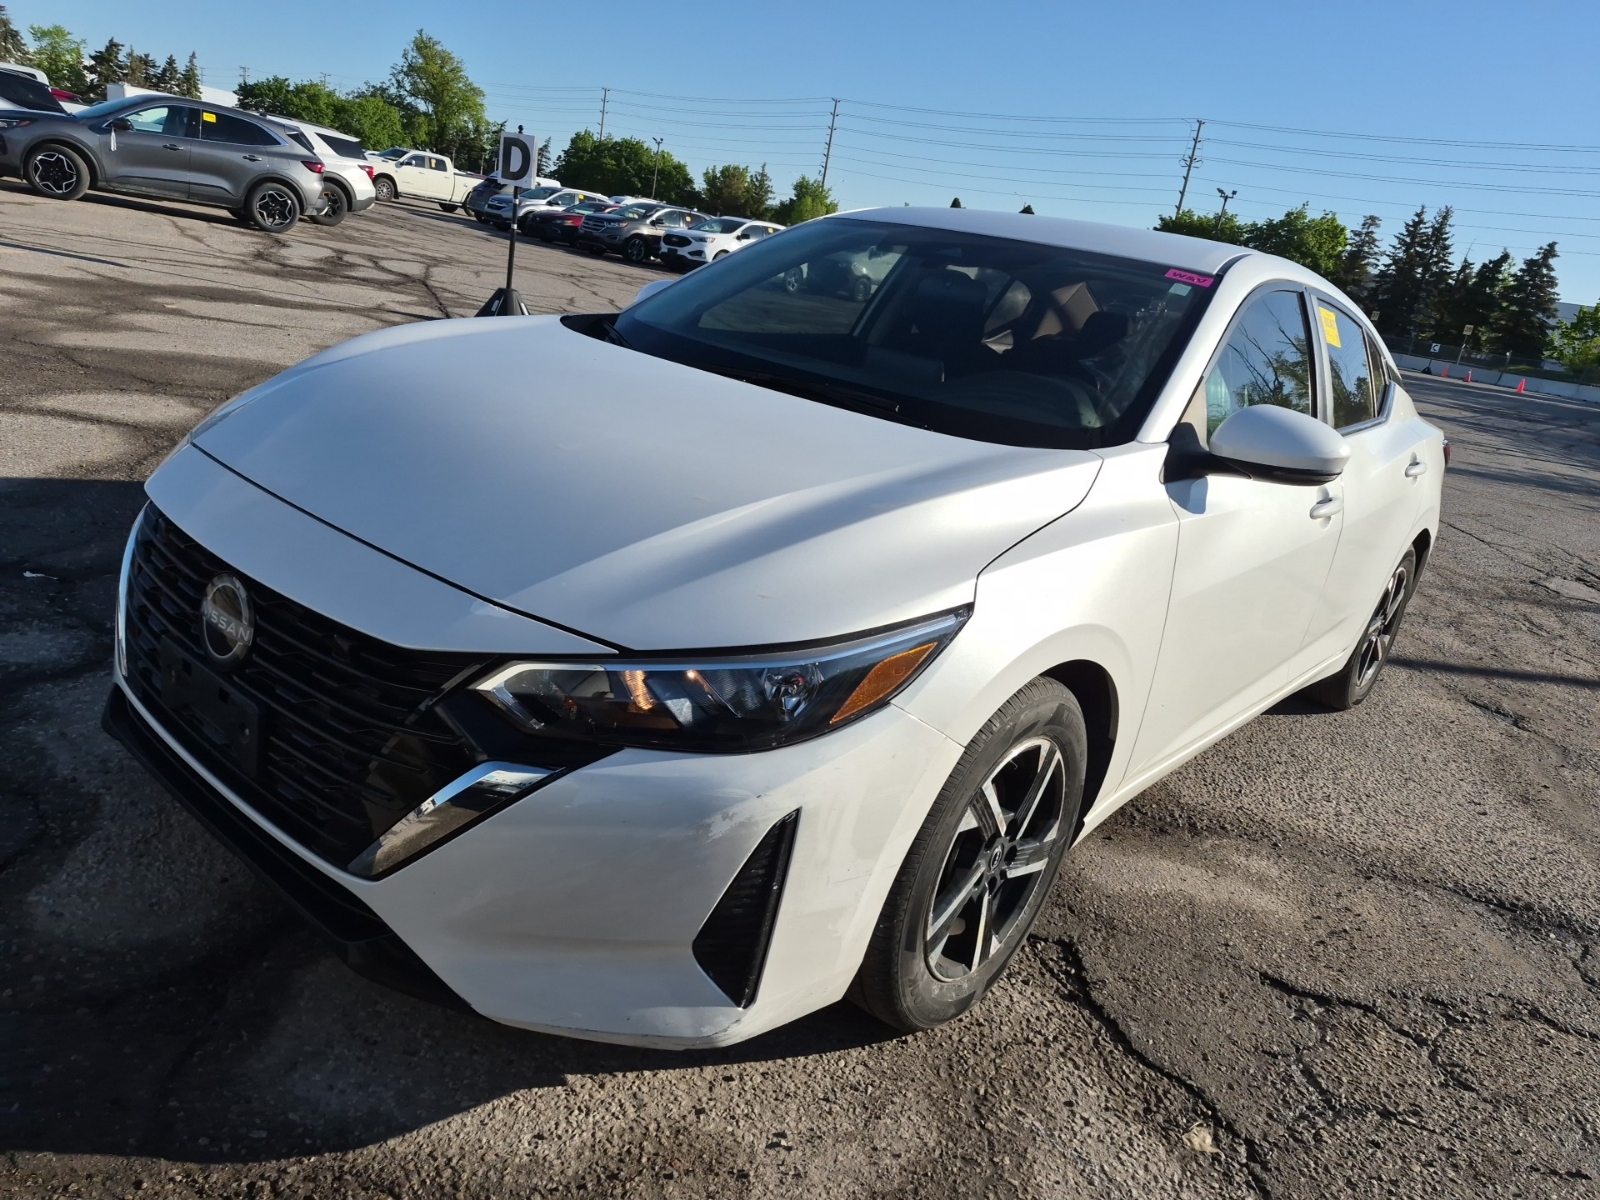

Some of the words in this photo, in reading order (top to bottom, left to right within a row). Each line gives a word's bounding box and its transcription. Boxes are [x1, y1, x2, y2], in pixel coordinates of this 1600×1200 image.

[501, 136, 531, 181] D
[1432, 344, 1440, 352] C
[201, 600, 250, 642] NISSAN
